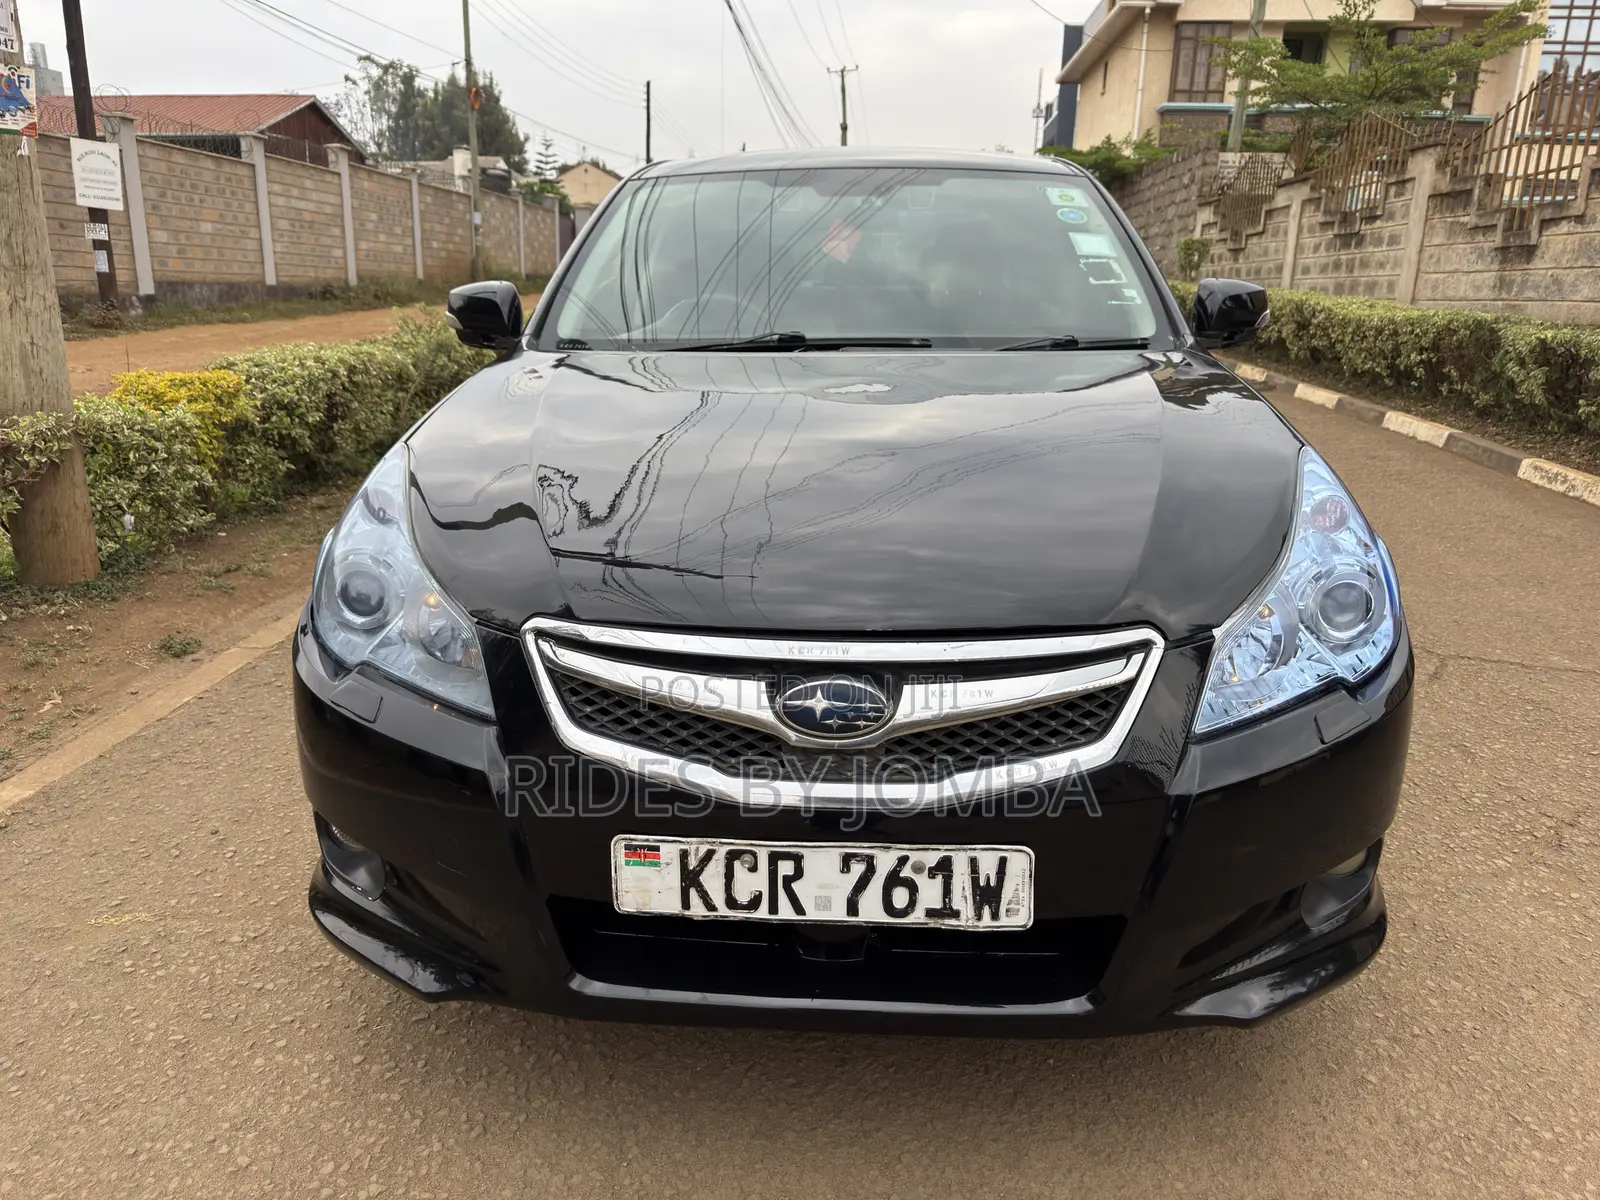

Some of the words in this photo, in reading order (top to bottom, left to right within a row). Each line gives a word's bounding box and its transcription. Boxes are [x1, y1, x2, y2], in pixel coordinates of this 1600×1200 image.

[0, 37, 14, 50] 47
[679, 847, 807, 916] KCR
[838, 851, 1009, 921] 761W
